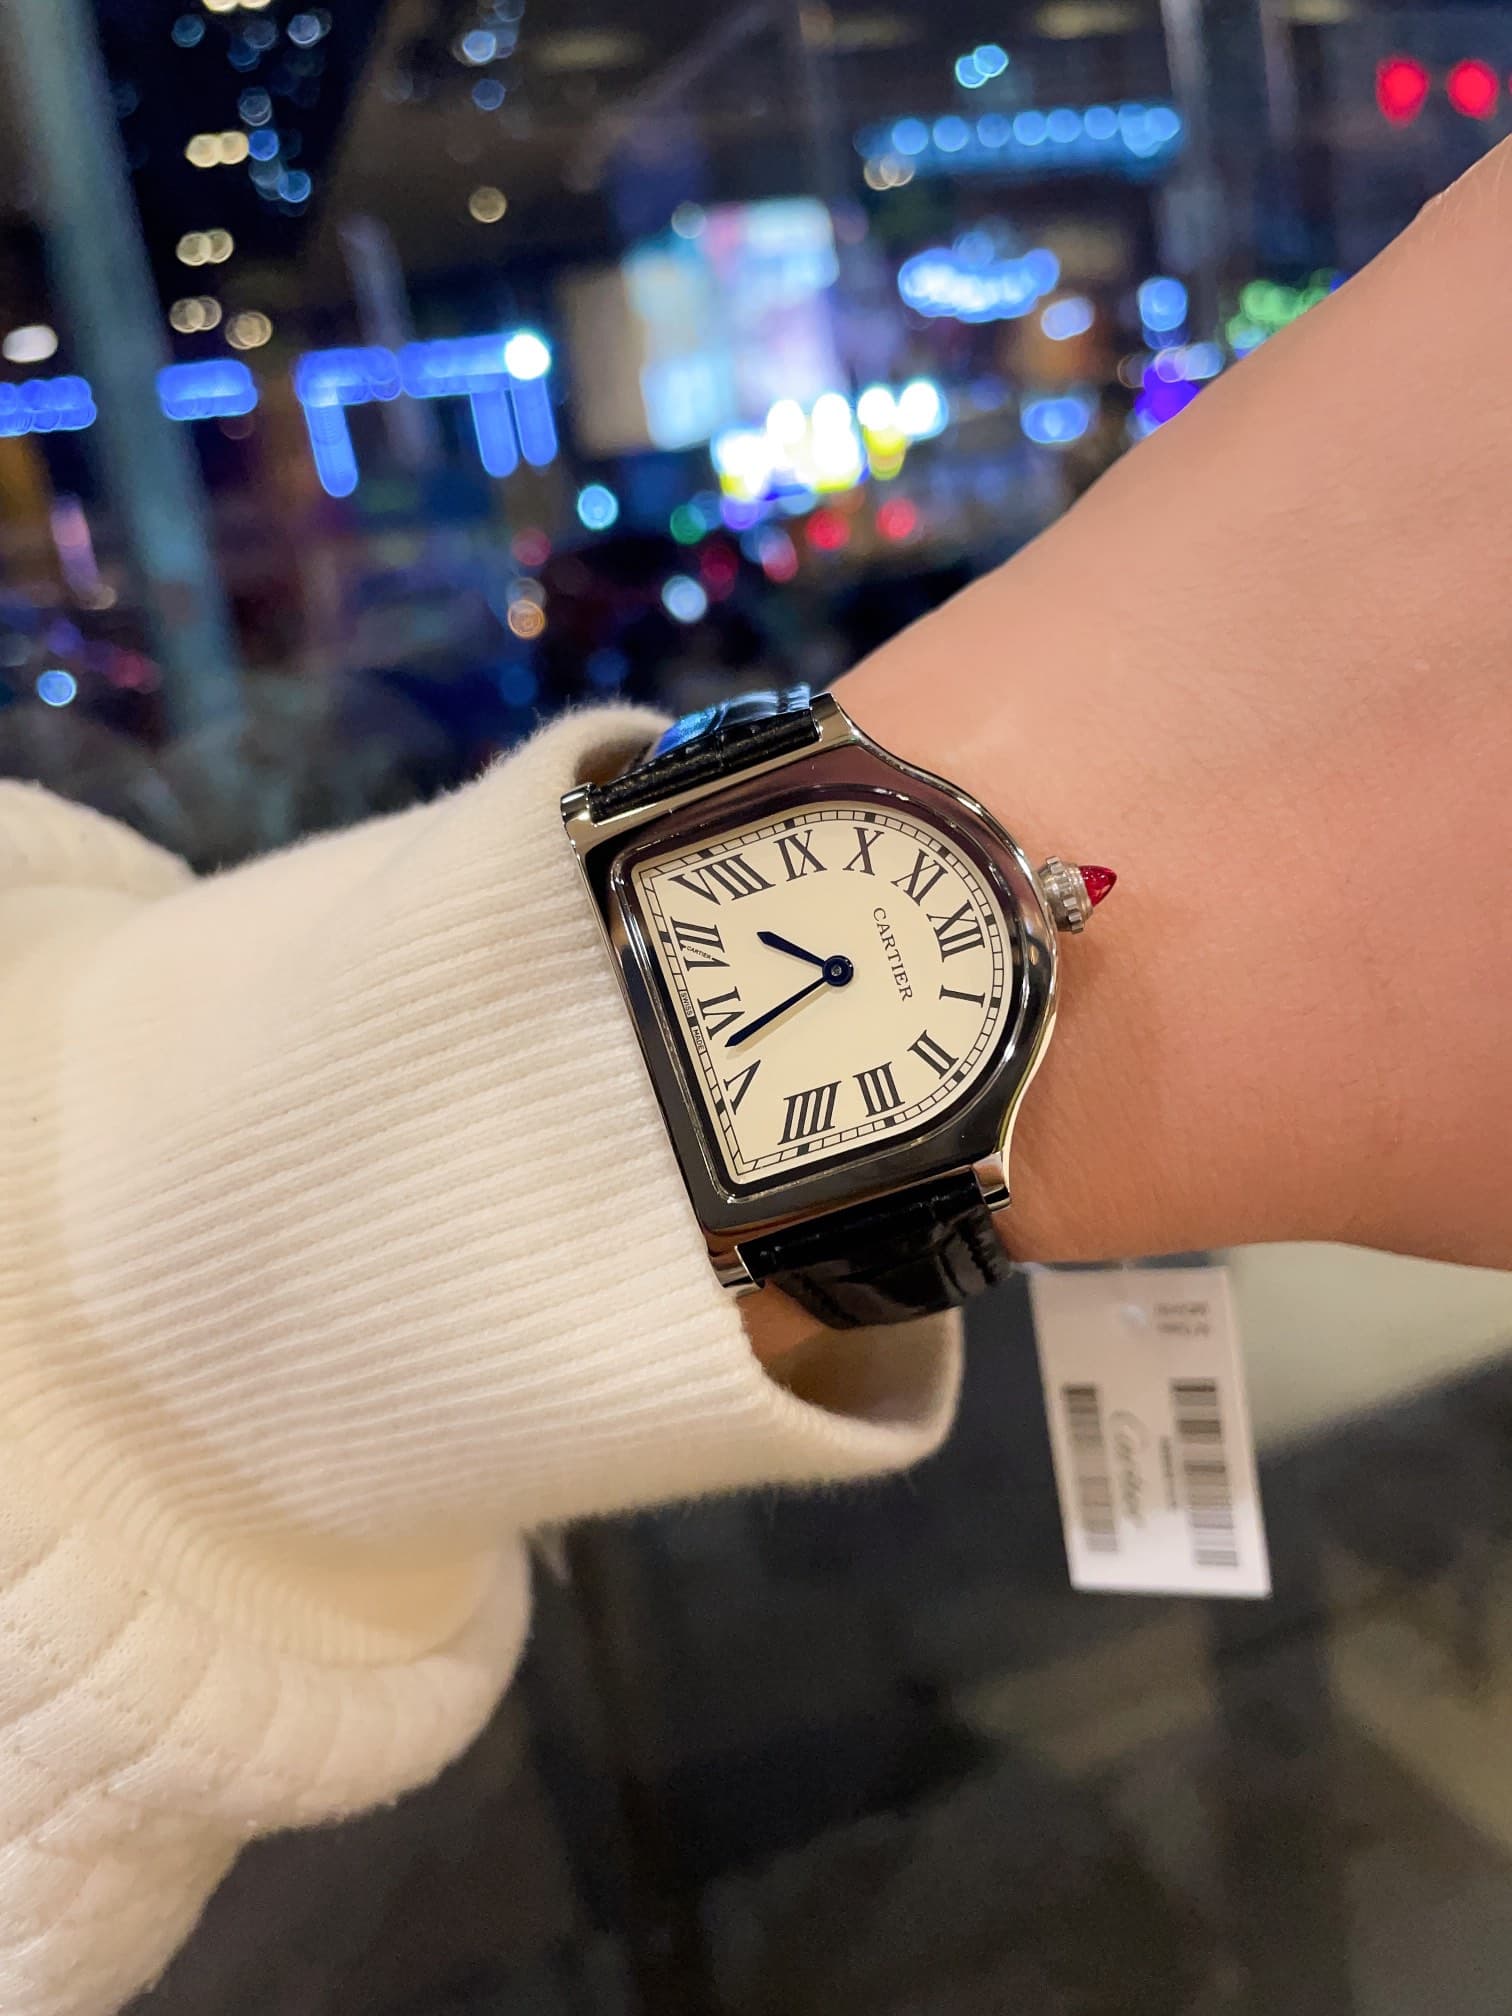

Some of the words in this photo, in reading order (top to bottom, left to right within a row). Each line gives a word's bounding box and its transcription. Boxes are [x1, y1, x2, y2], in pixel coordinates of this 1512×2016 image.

[773, 829, 827, 881] IX
[843, 826, 884, 876] X
[890, 848, 948, 906] XI
[668, 853, 776, 905] VIII
[670, 916, 729, 971] VII
[686, 945, 711, 960] CARTIER
[873, 907, 912, 1001] CARTIER
[926, 899, 985, 963] XII
[680, 991, 693, 1016] SWISS
[692, 1028, 705, 1051] MADE
[697, 986, 745, 1040] VI
[939, 984, 985, 1008] I
[907, 1030, 959, 1079] II
[723, 1060, 761, 1115] V
[777, 1081, 841, 1145] IIII
[853, 1061, 905, 1117] III
